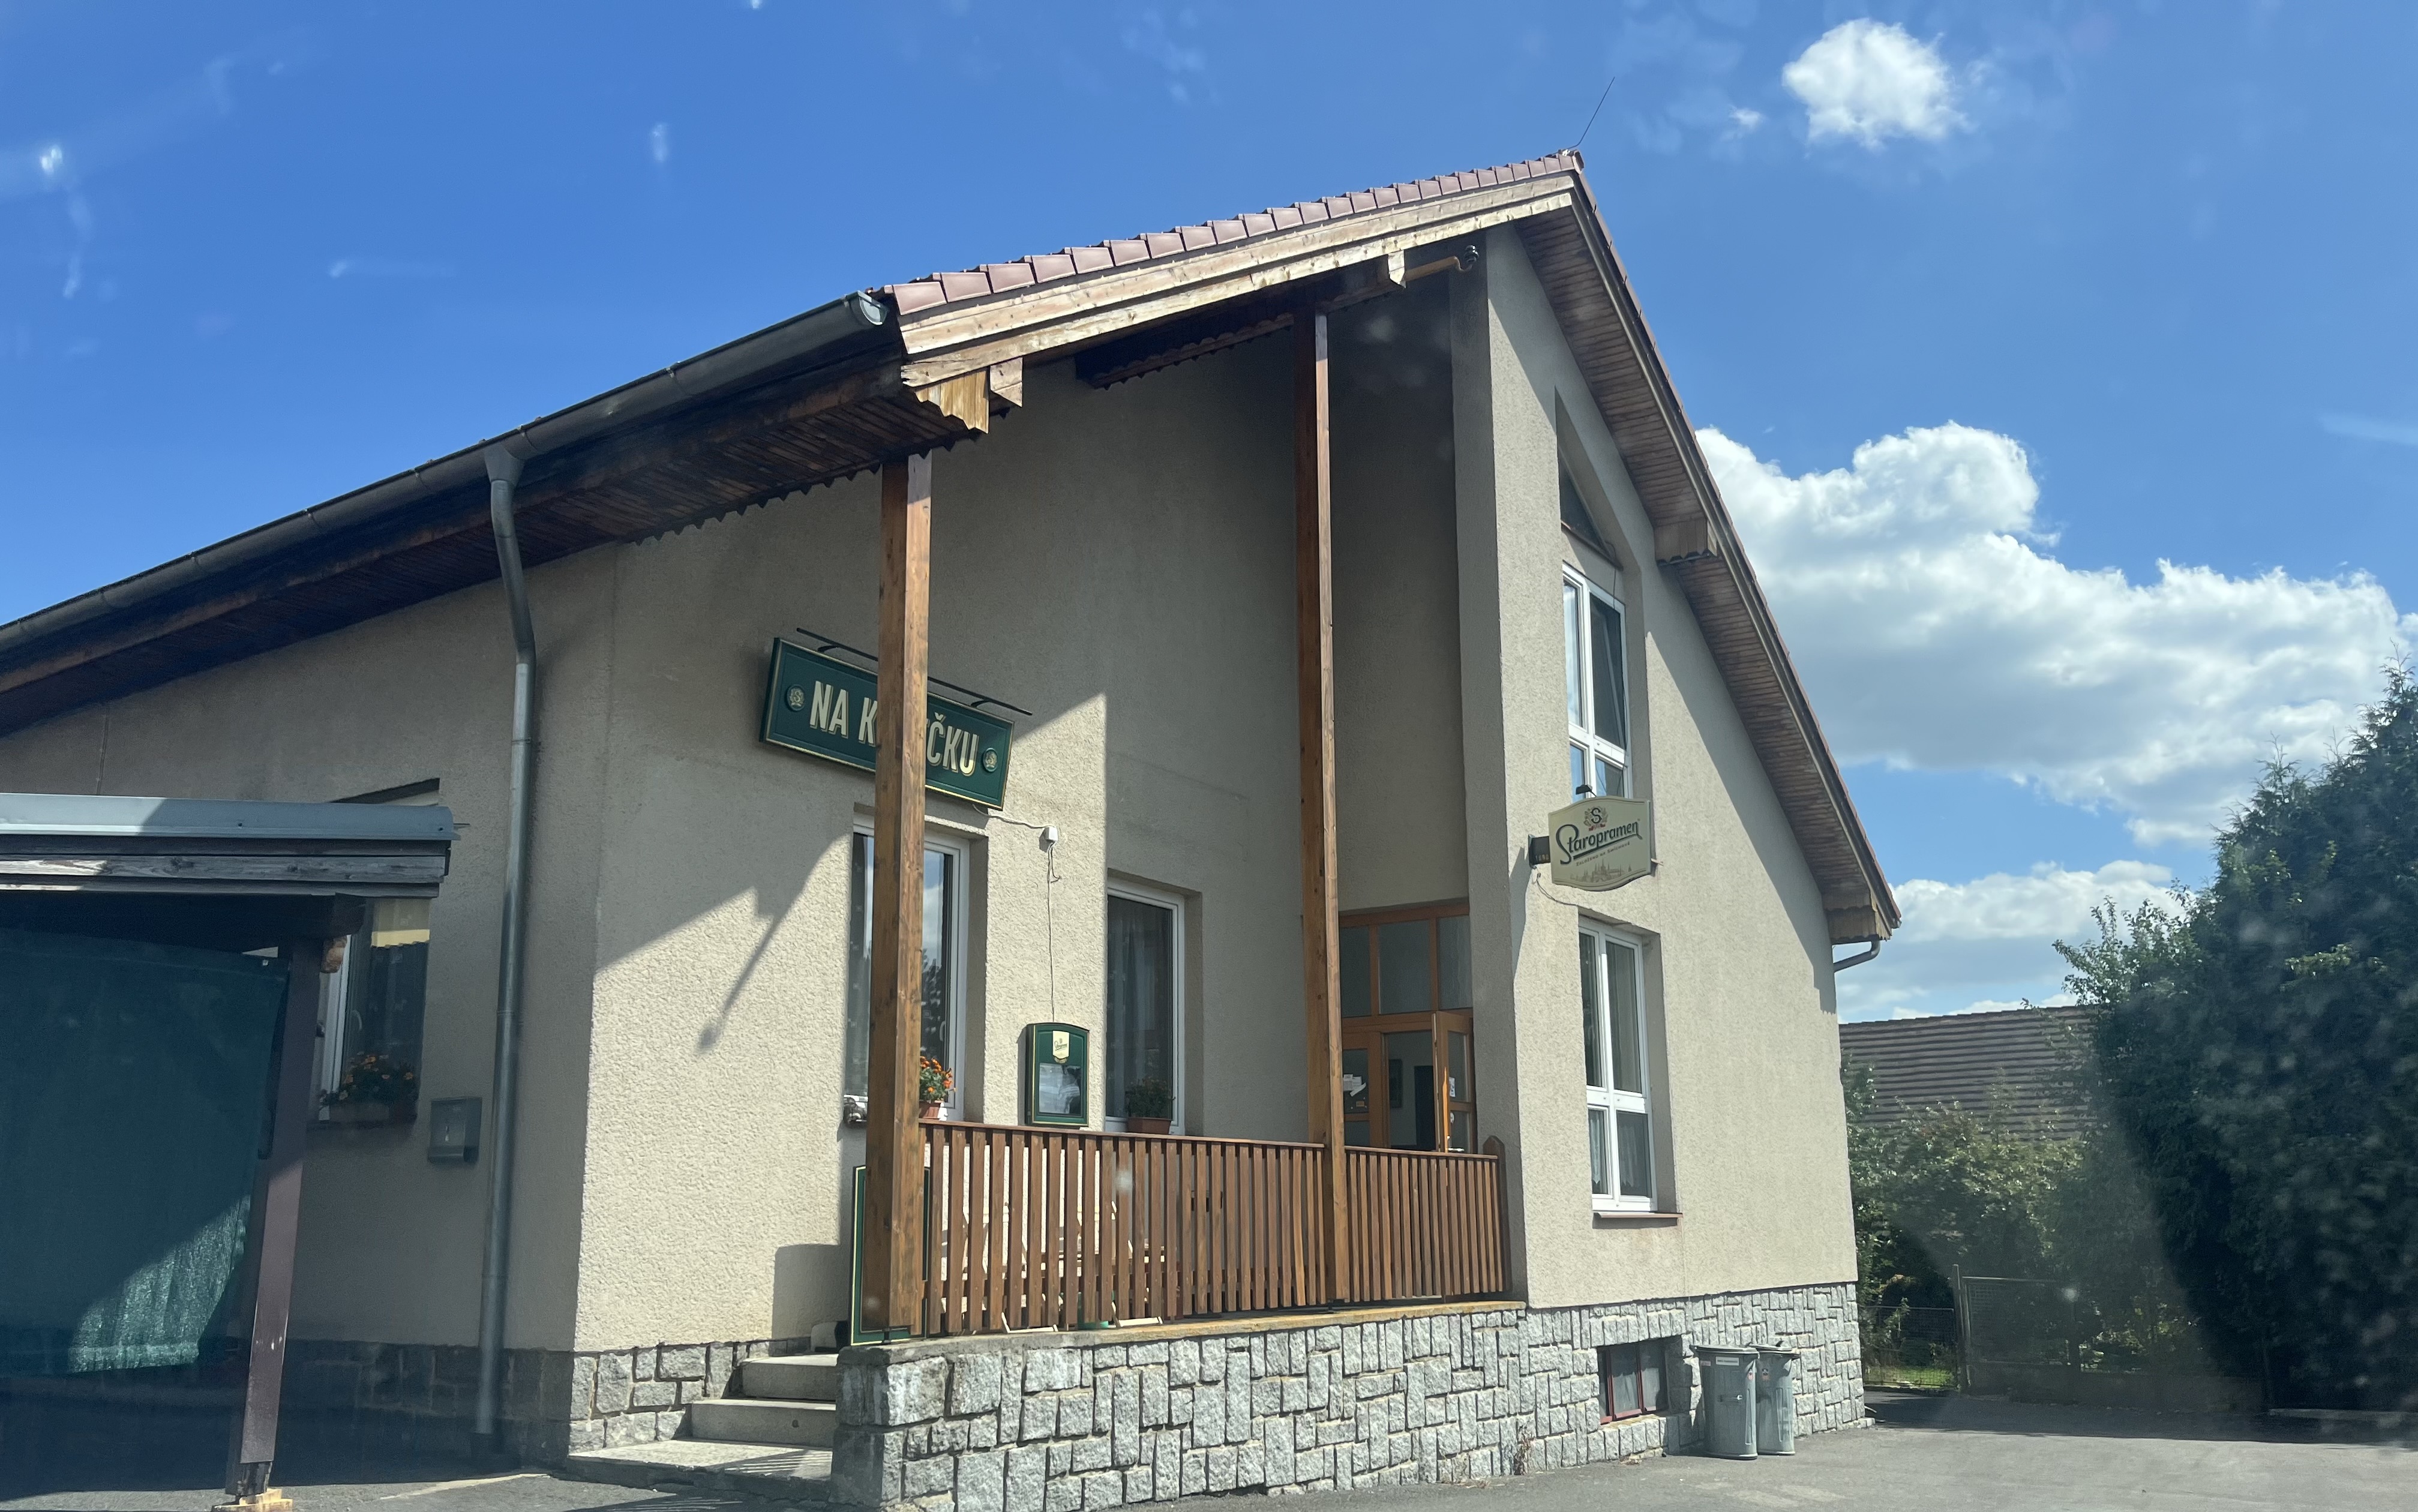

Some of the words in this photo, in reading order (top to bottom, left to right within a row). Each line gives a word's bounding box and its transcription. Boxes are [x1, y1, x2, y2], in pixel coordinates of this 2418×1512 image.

[809, 681, 848, 739] NA
[859, 697, 979, 776] KČKU
[1591, 808, 1603, 824] S
[1556, 821, 1642, 865] Staropramen
